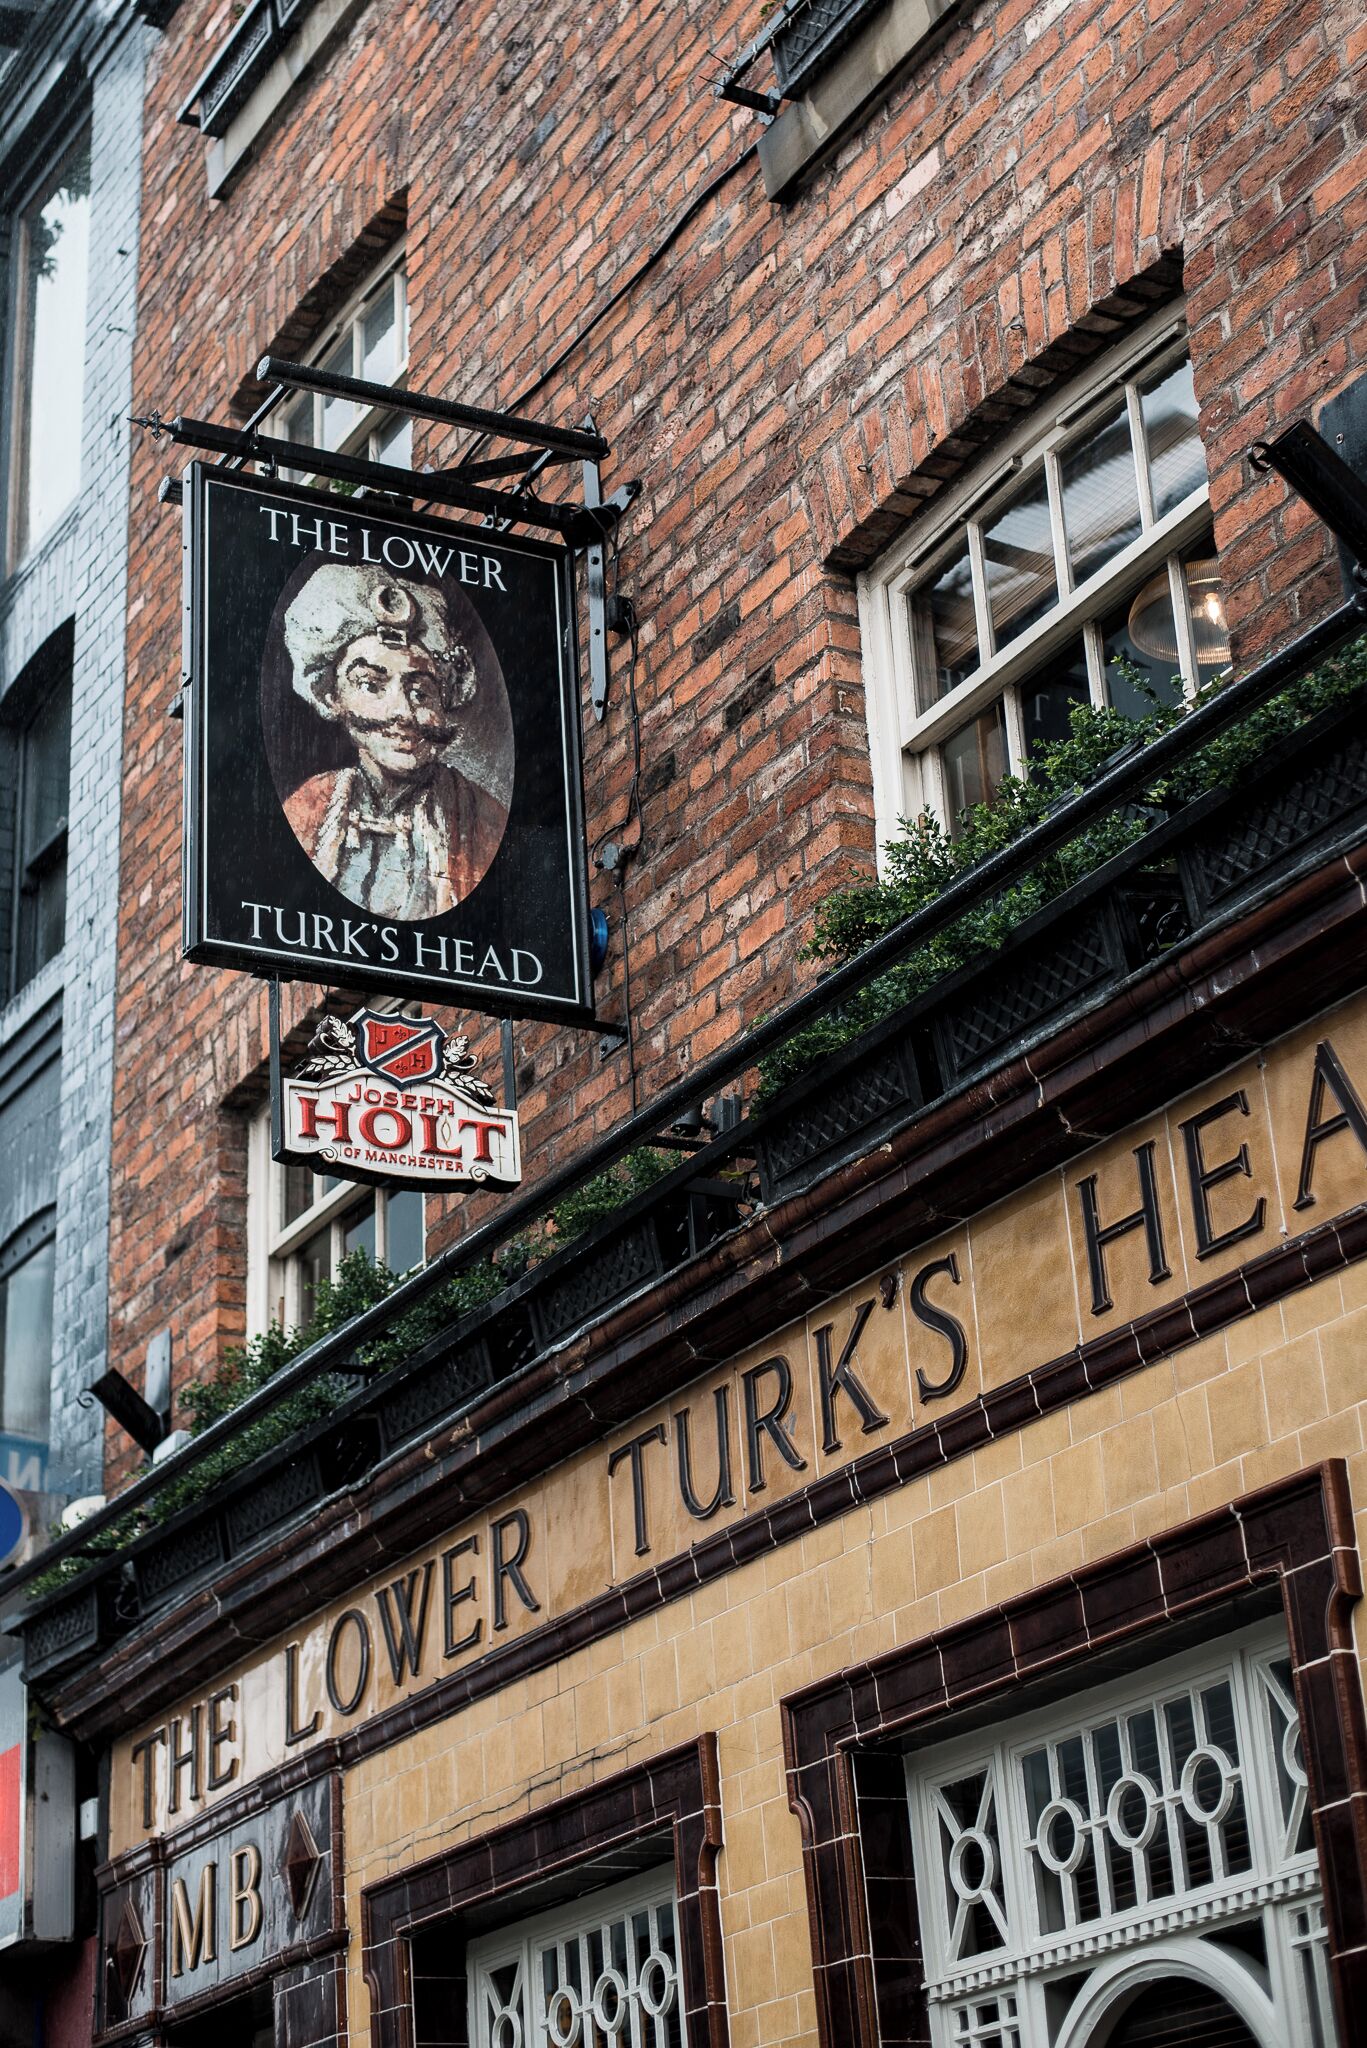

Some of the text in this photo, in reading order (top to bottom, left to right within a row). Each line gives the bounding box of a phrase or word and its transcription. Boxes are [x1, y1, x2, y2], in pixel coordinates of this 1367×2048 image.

[260, 507, 507, 592] THE LOWER
[413, 932, 544, 986] HEAD
[297, 1095, 506, 1163] HOLT
[347, 1083, 455, 1115] JOSEPH
[343, 1147, 464, 1173] OF MANCHESTER
[132, 1683, 239, 1830] THE
[284, 1508, 541, 1746] LOWER
[171, 1844, 262, 1979] MB
